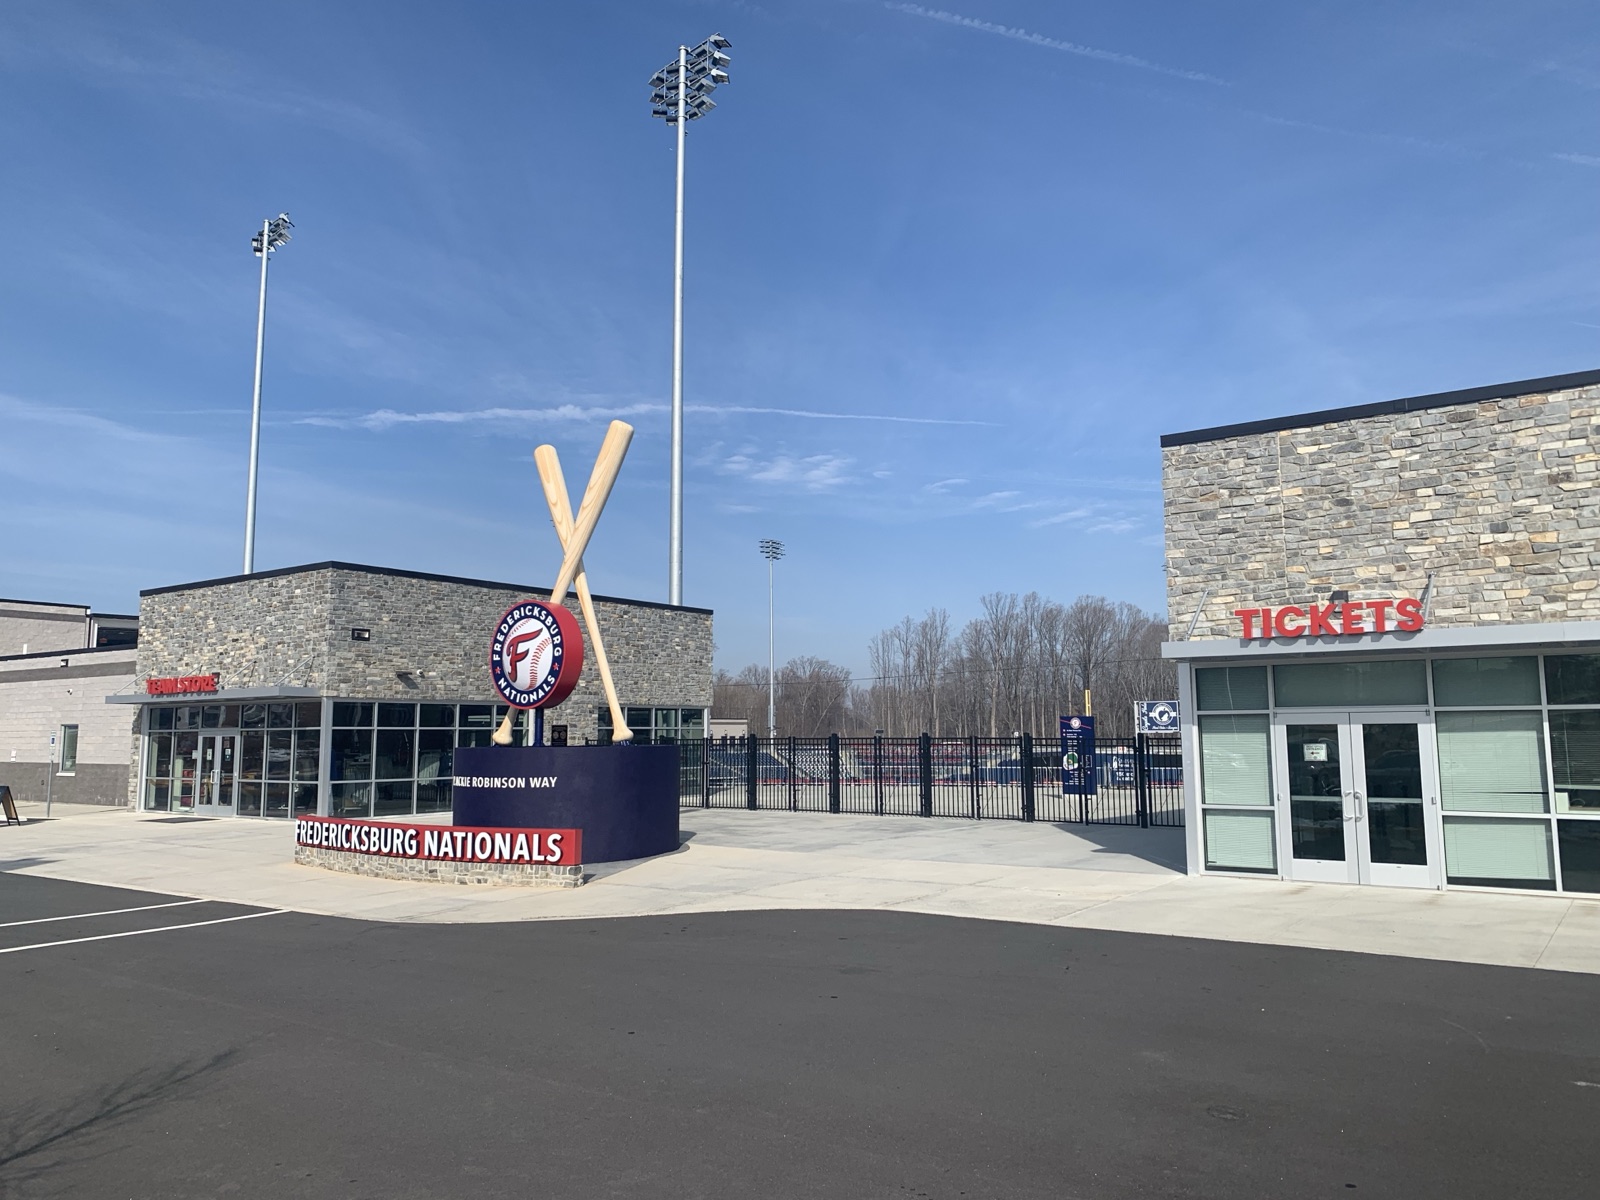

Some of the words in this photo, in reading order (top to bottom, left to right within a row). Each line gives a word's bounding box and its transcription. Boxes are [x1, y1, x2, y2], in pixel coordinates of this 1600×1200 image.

[493, 605, 562, 661] FREDERICKSBURG
[1234, 597, 1424, 640] TICKETS
[147, 678, 178, 695] TEAM
[178, 674, 217, 693] STORE
[498, 674, 555, 704] NATIONALS
[472, 777, 526, 788] ROBINSON
[529, 776, 557, 788] WAY
[295, 820, 417, 856] FREDERICKSBURG
[424, 830, 563, 863] NATIONALS
